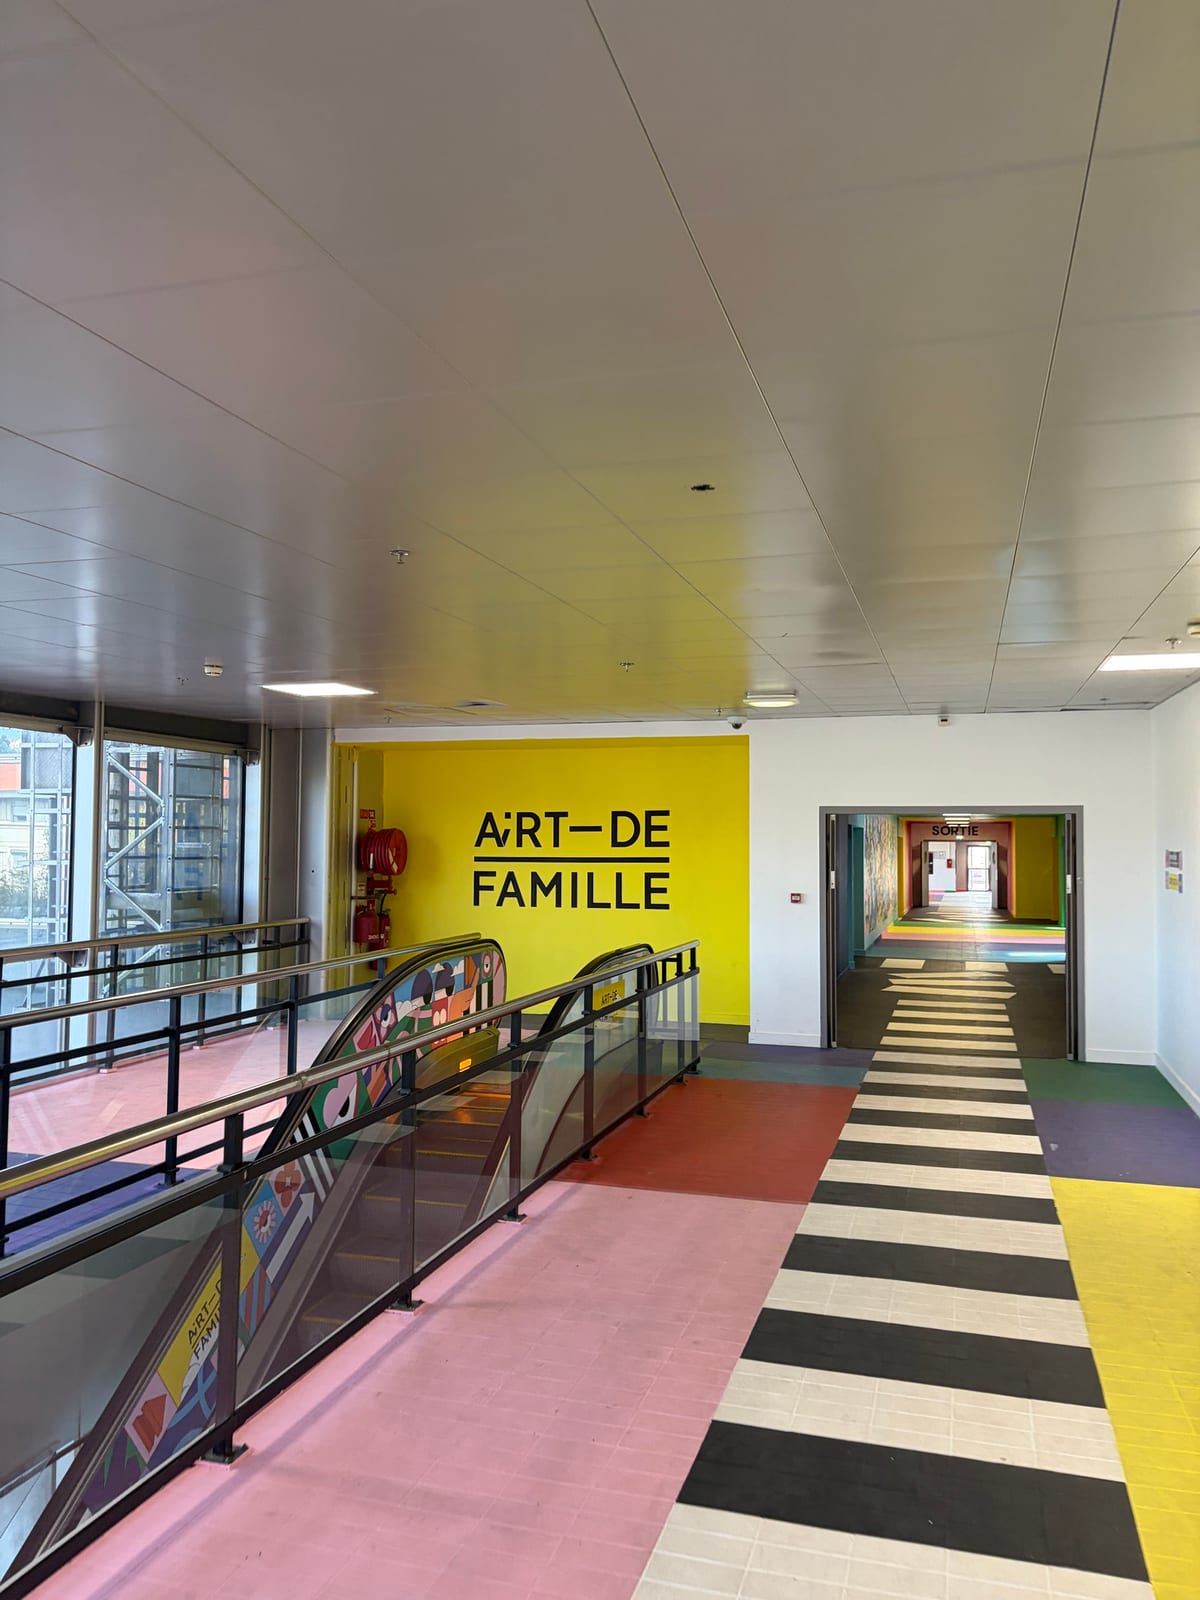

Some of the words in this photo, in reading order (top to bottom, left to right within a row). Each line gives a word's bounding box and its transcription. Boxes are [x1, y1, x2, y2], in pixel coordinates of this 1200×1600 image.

[932, 825, 979, 836] SORTIE
[473, 870, 670, 910] FAMILLE
[194, 1307, 221, 1360] FAMI
